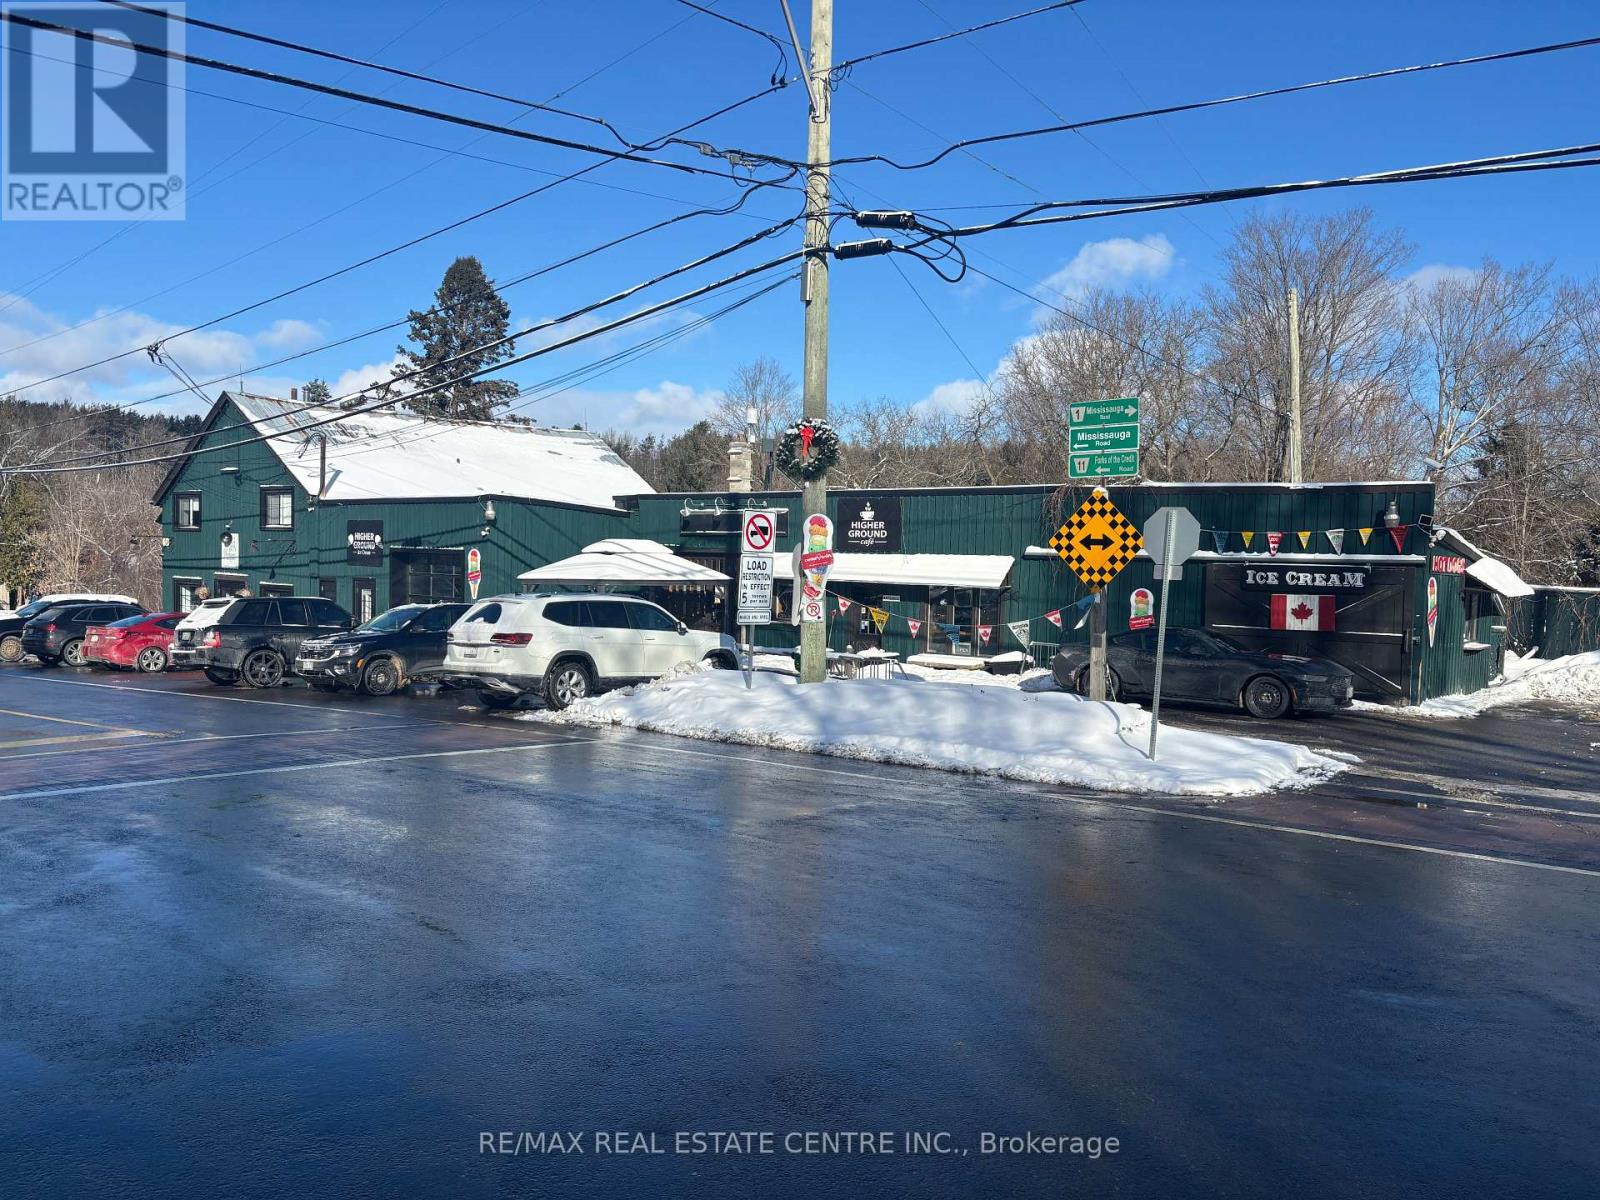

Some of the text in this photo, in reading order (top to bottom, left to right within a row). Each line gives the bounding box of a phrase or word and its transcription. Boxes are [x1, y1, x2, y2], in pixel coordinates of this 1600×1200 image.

[1087, 405, 1124, 415] Mississauga
[1077, 431, 1131, 441] Mississauga
[1094, 454, 1135, 465] Forks of the Credit
[1078, 460, 1085, 471] 11
[851, 521, 885, 529] HIGHER
[354, 532, 375, 541] HIGHER
[848, 530, 887, 538] GROUND
[353, 541, 375, 550] GROUND
[860, 538, 875, 547] café
[747, 560, 768, 571] LOAD
[742, 572, 771, 581] RESTRICTION
[1245, 570, 1366, 588] ICE CREAM
[750, 583, 770, 591] EFFECT
[741, 592, 748, 604] 5
